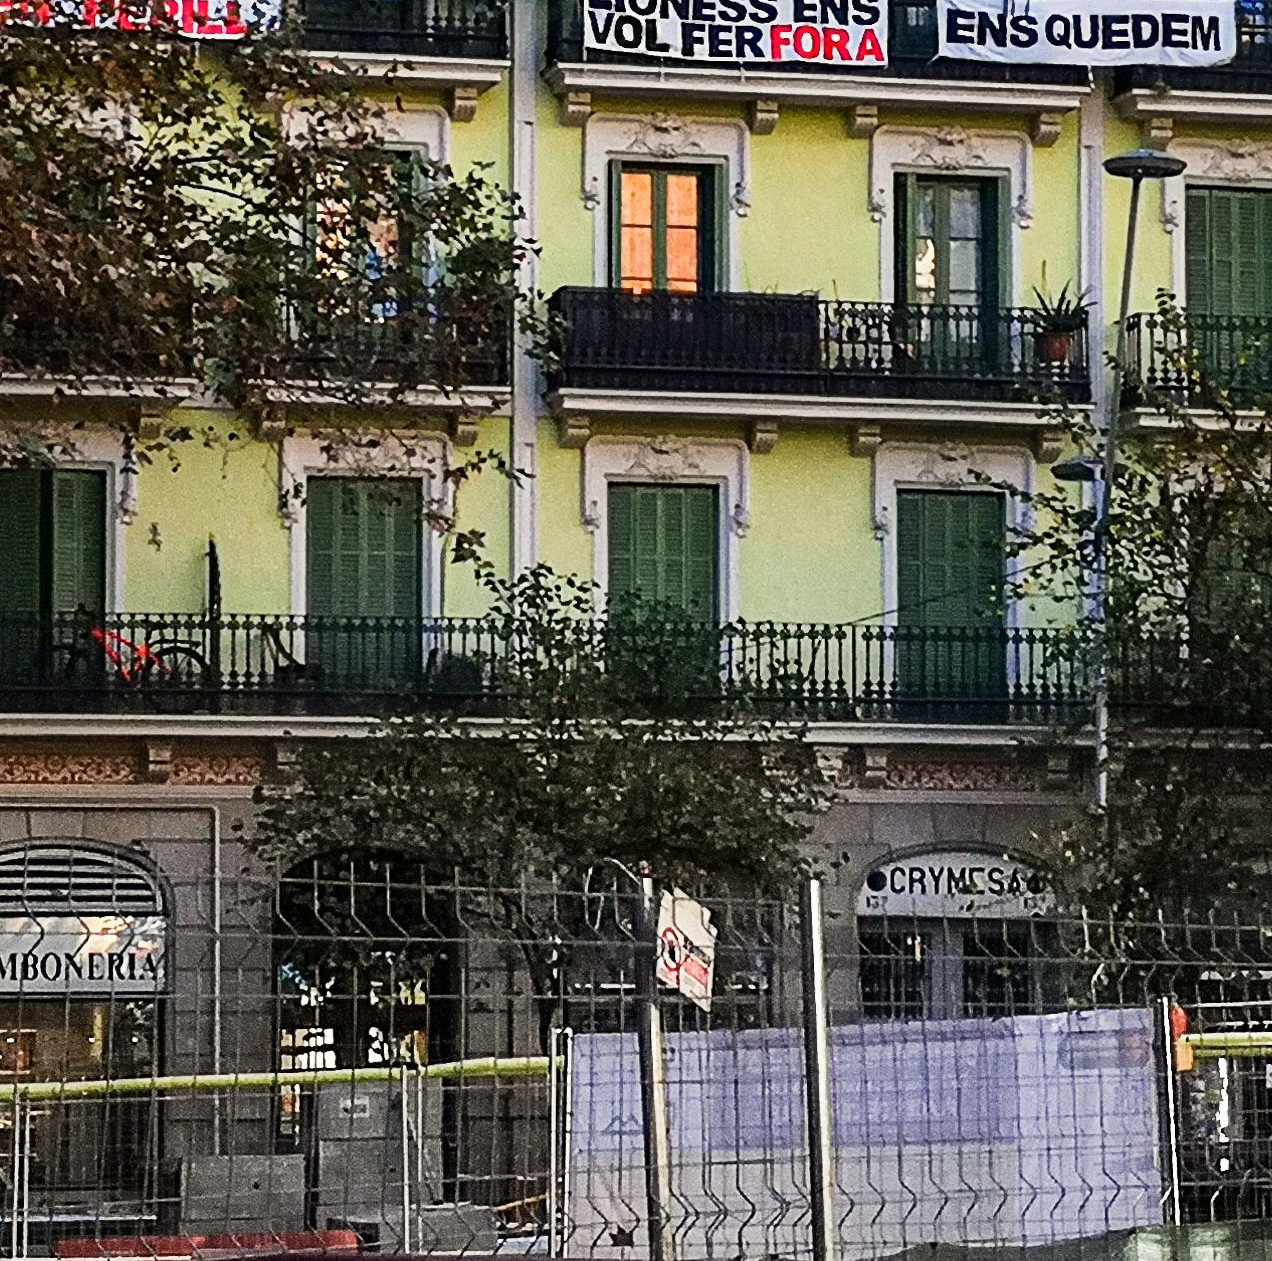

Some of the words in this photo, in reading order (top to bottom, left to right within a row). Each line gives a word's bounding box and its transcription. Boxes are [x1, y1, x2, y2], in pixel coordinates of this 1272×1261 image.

[588, 10, 670, 52] VOL
[680, 22, 764, 58] FER
[770, 24, 885, 61] FORA
[946, 8, 1039, 48] ENS
[1045, 13, 1222, 51] QUEDEM
